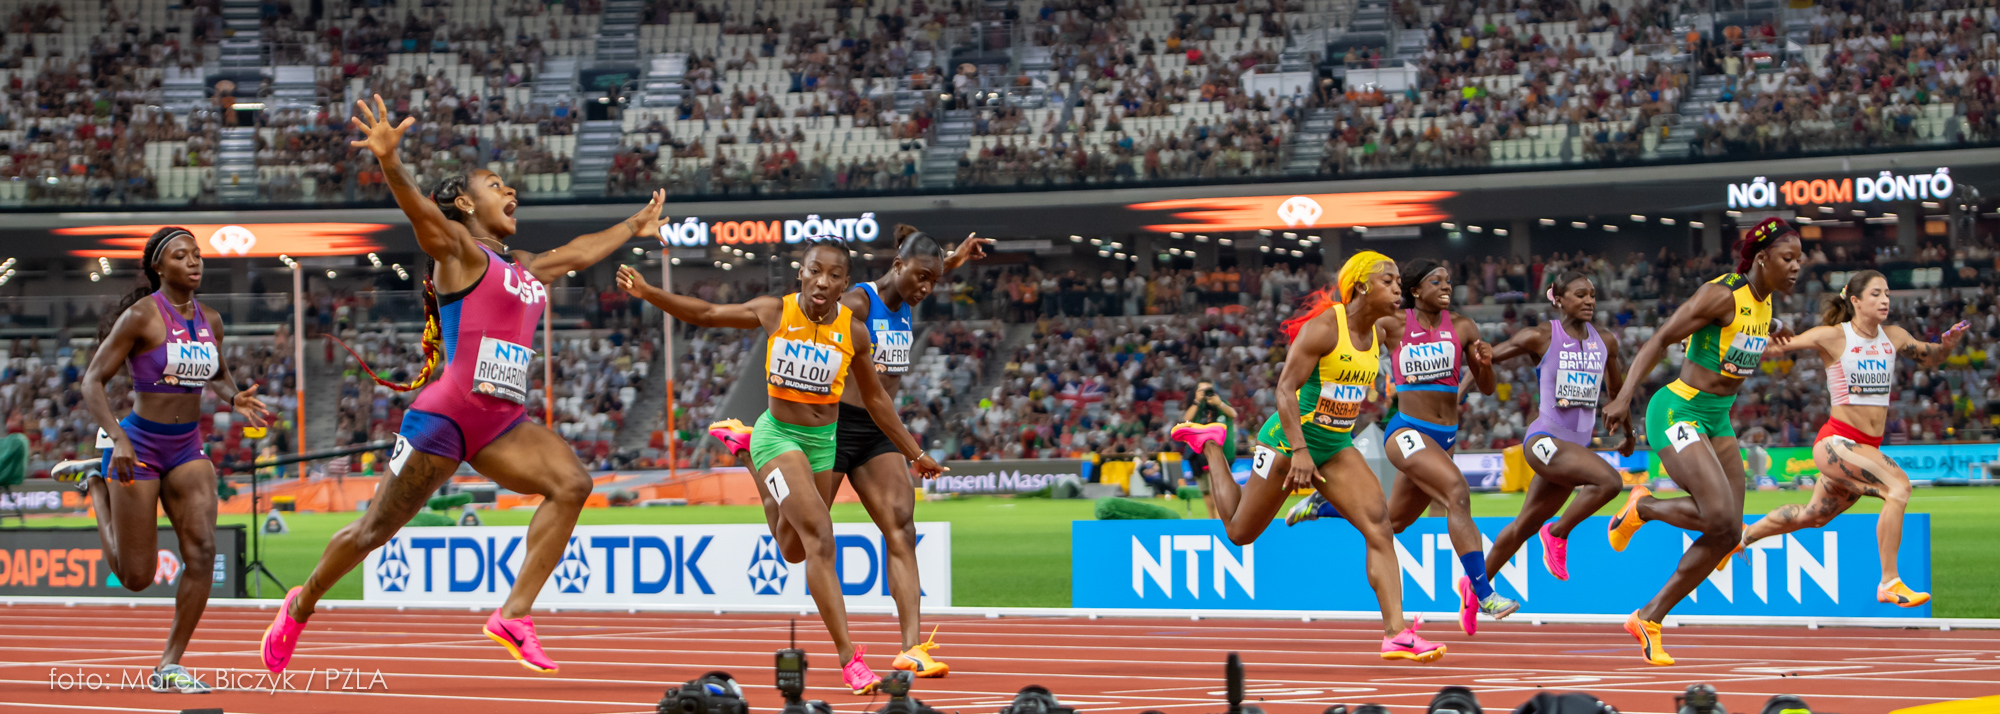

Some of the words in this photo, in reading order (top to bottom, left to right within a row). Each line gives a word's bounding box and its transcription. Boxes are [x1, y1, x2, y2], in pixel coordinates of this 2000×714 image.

[1727, 176, 1777, 208] NŐI
[1780, 178, 1853, 205] 100M
[1855, 166, 1953, 203] DÖNTŐ
[660, 216, 708, 246] NŐI
[711, 220, 781, 244] 100M
[784, 212, 879, 244] DÖNTŐ
[503, 268, 547, 304] USA
[885, 332, 909, 346] NTN
[179, 345, 211, 361] NTN
[495, 341, 531, 366] NTN
[784, 341, 830, 365] NTN
[1409, 342, 1444, 359] NTN
[1559, 350, 1602, 361] GREAT
[176, 362, 211, 377] DAVIS
[776, 358, 795, 376] TA
[799, 363, 831, 383] LOU
[1405, 356, 1450, 373] BROWN
[1558, 360, 1603, 370] BRITAIN
[1857, 359, 1887, 371] NTN
[1567, 372, 1598, 386] NTN
[1334, 385, 1363, 400] NTN
[1677, 425, 1689, 441] 4
[391, 439, 404, 460] 9
[1403, 434, 1415, 450] 3
[1537, 443, 1551, 458] 2
[1256, 452, 1267, 469] 5
[769, 476, 780, 498] 7
[410, 536, 523, 593] TDK
[590, 535, 716, 595] TDK
[1132, 534, 1255, 600] NTN
